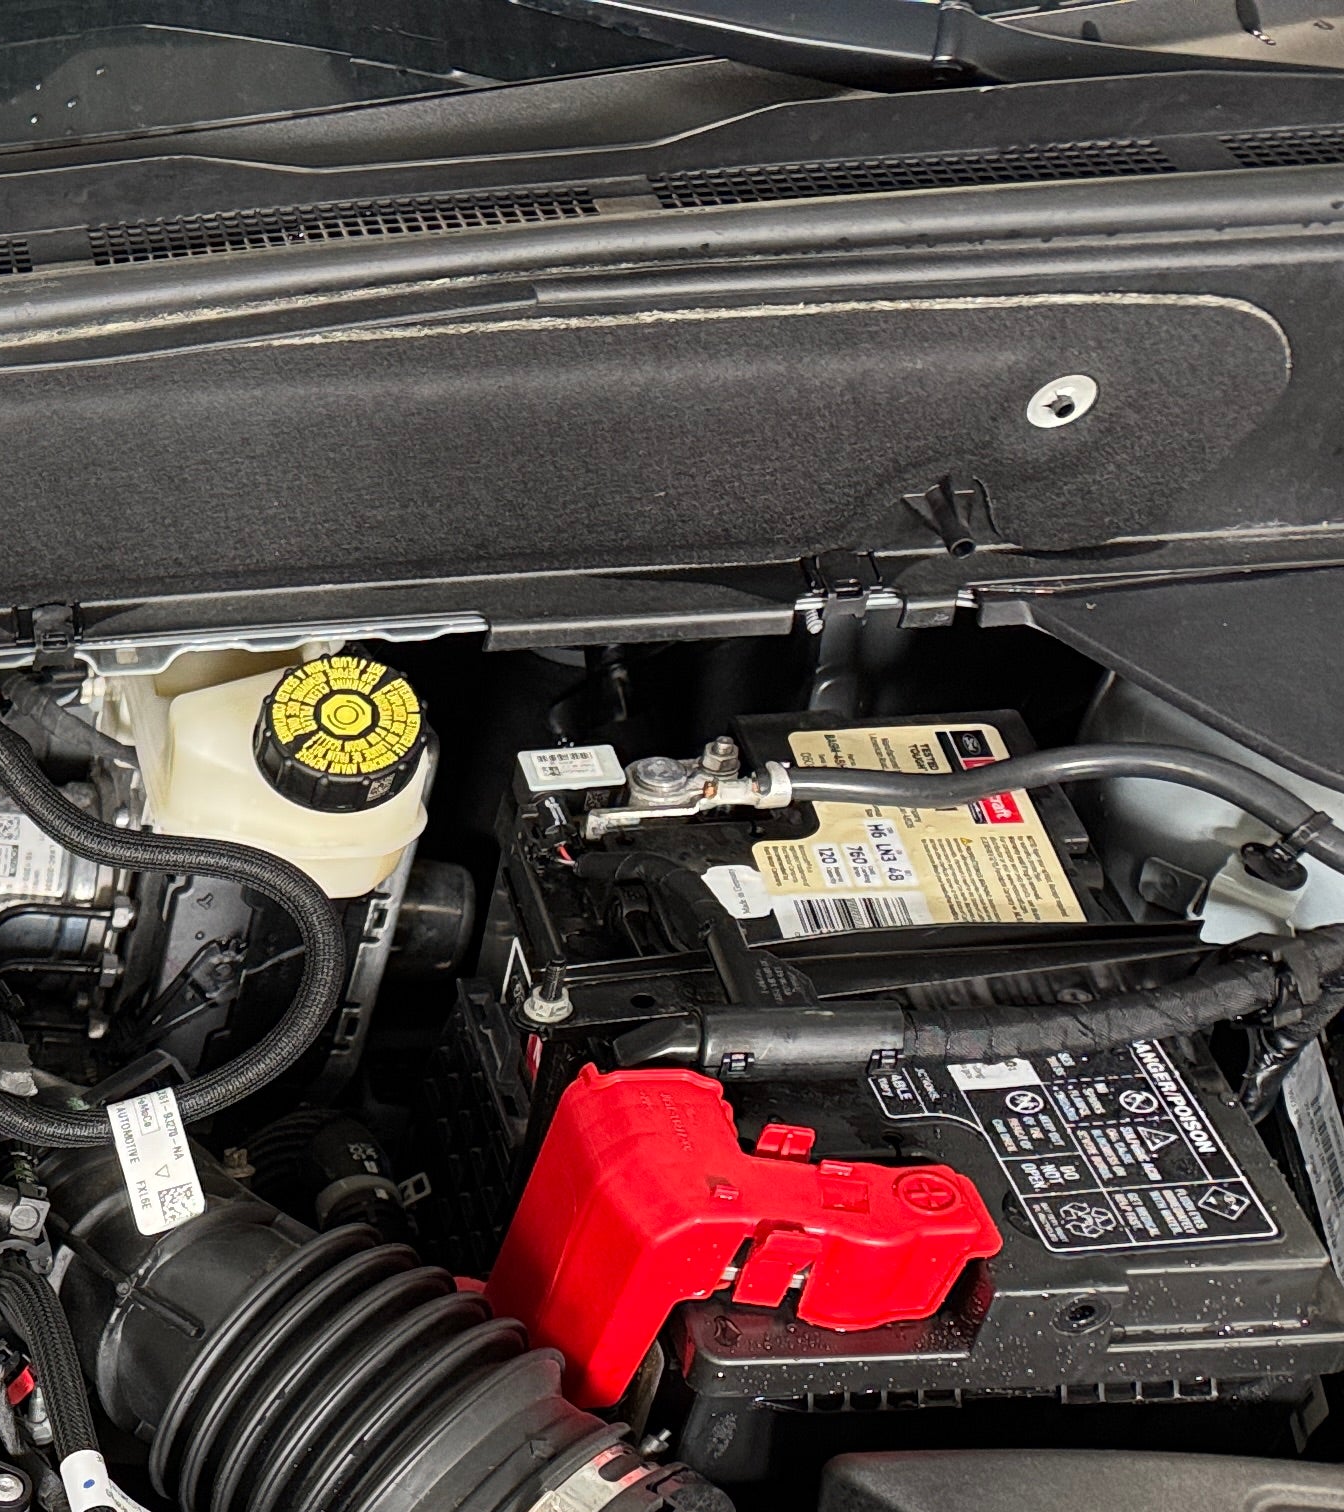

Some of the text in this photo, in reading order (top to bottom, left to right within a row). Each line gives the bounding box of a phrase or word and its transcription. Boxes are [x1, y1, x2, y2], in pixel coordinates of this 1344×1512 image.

[302, 658, 329, 675] FROM
[329, 656, 358, 668] FLUID
[918, 743, 939, 770] TESTED
[817, 847, 837, 863] 120
[847, 845, 867, 863] 760
[867, 824, 903, 880] H6 LN3 48
[116, 1107, 141, 1164] AUTOMOTIVE
[1038, 1163, 1064, 1185] NOT
[1057, 1165, 1080, 1180] DO
